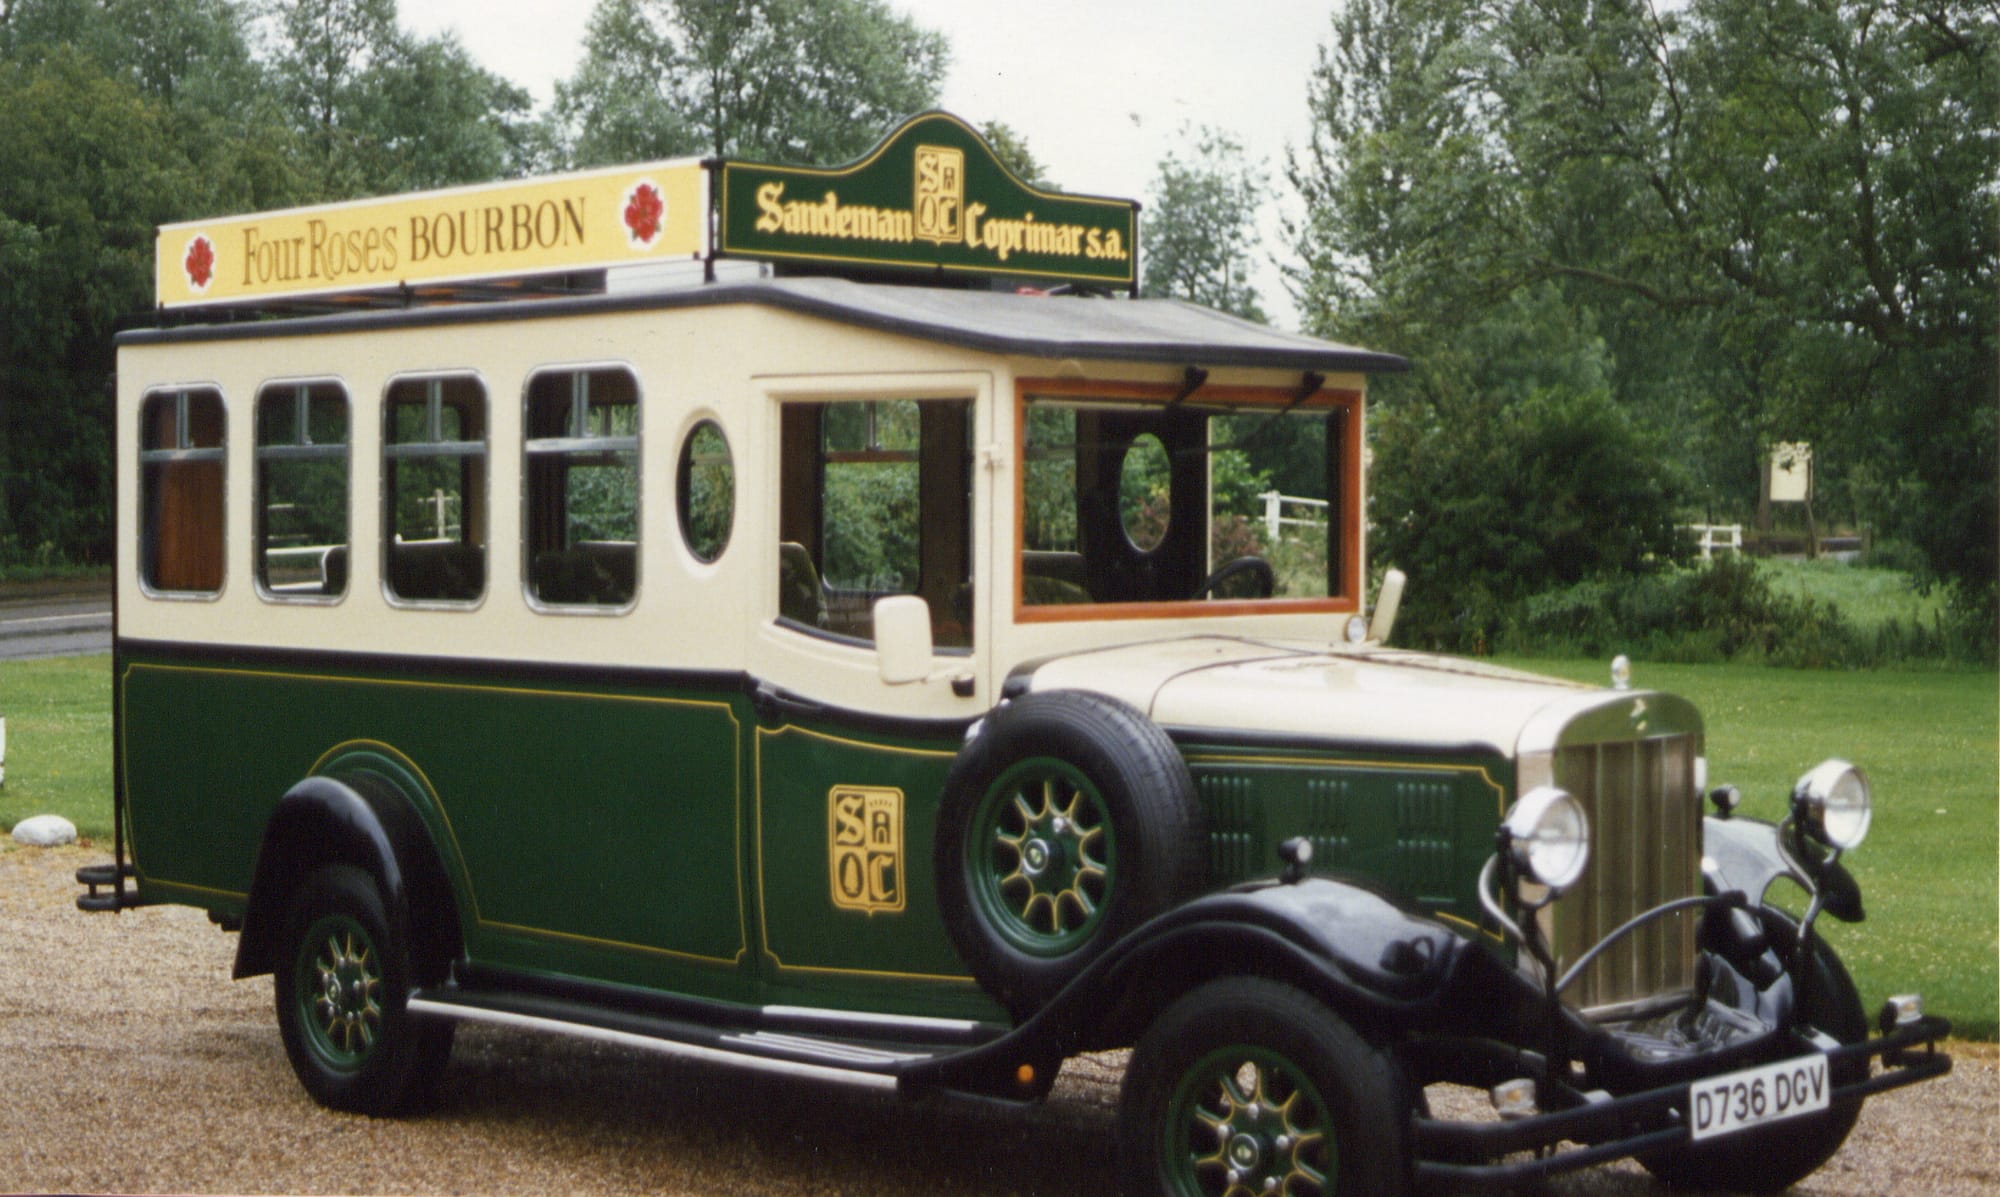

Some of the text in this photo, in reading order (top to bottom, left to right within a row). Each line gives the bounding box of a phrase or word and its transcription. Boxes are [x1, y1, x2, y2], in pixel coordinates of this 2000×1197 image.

[410, 197, 586, 262] BOURBON
[755, 182, 1128, 260] Sandeman Coprimar s.a.
[1696, 1063, 1824, 1130] D736 DGV
